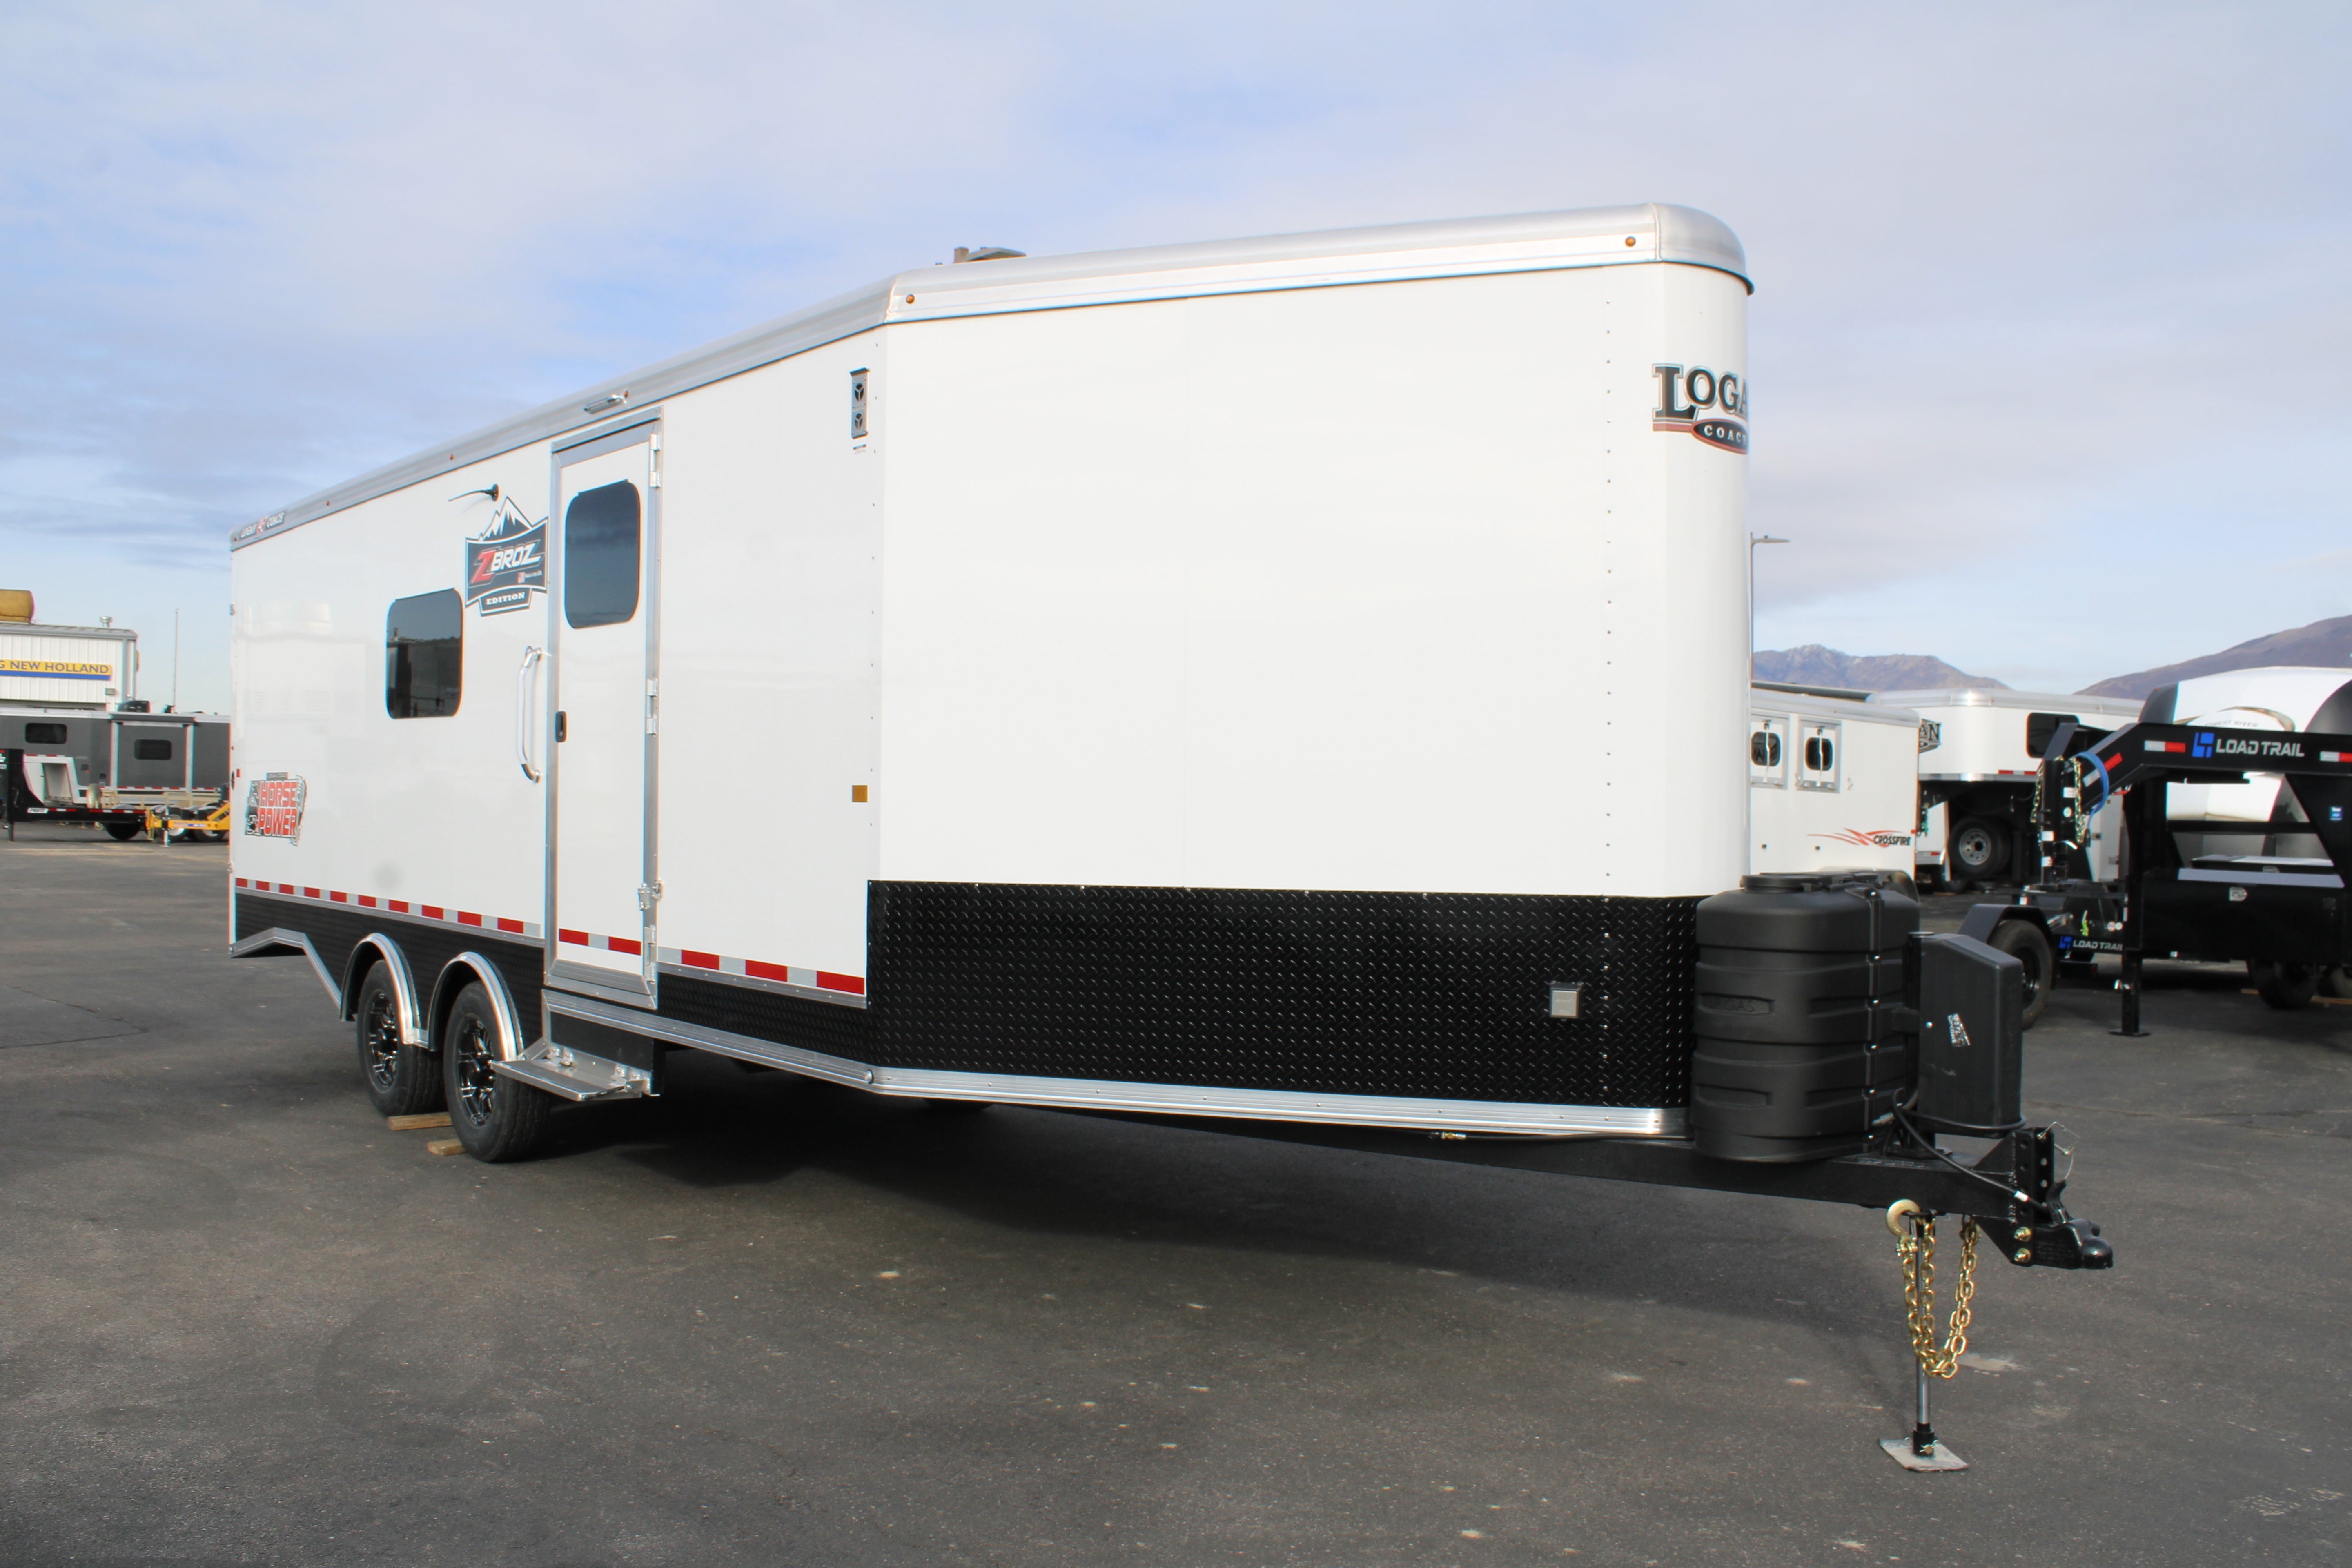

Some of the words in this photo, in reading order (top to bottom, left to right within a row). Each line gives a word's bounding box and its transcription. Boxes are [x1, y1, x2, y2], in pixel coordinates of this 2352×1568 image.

[471, 543, 542, 584] ZBROZ
[486, 592, 525, 605] EDITION
[10, 661, 40, 670] NEW
[45, 663, 109, 673] HOLLAND
[2216, 739, 2259, 755] LOAD
[2261, 741, 2305, 757] TRAIL
[258, 780, 298, 807] HORSE
[257, 807, 298, 837] POWER
[1874, 835, 1911, 846] CROSSFIRE
[2073, 940, 2098, 949] LOAD
[1724, 998, 1755, 1012] GAS
